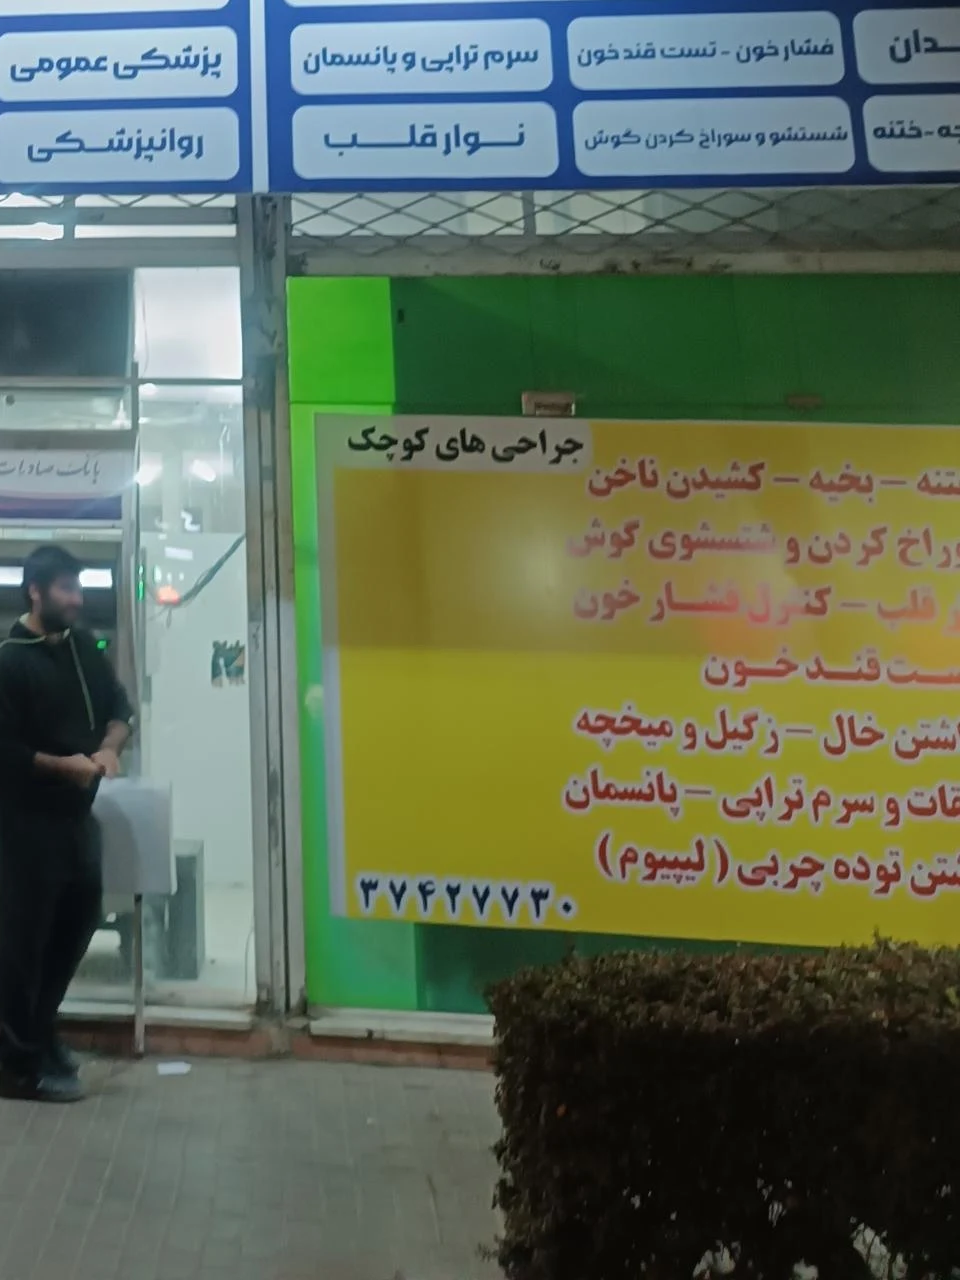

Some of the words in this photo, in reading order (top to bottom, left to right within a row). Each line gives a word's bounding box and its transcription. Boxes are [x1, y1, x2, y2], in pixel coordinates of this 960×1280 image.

[113, 45, 222, 80] پزشکی
[303, 45, 397, 74] پانسمان
[402, 51, 416, 69] و
[421, 43, 478, 73] تراپی
[483, 48, 539, 70] سرم
[577, 43, 619, 67] خون
[624, 42, 656, 59] قند
[660, 41, 716, 58] تست
[736, 39, 779, 63] خون
[783, 38, 835, 62] فشار
[889, 28, 960, 63] دان
[10, 55, 108, 82] عمومی
[27, 127, 204, 162] روانپزشکی
[324, 123, 437, 156] قلب
[443, 122, 526, 156] نوار
[584, 128, 641, 150] گوش
[645, 129, 694, 149] کردن
[699, 128, 751, 148] سوراخ
[755, 131, 767, 146] و
[770, 126, 848, 146] شستشو
[348, 426, 429, 461] کوچک
[436, 427, 486, 461] های
[492, 428, 583, 464] جراحی
[57, 451, 101, 484] بانک
[588, 458, 658, 496] ناخن
[666, 462, 765, 499] کشیدن
[809, 464, 874, 502] بخیه
[916, 469, 960, 495] تنه
[785, 535, 800, 564] و
[807, 527, 887, 565] کردن
[574, 579, 640, 618] خون
[650, 580, 739, 622] فشار
[877, 587, 935, 629] قلب
[704, 647, 798, 686] خون
[806, 648, 880, 682] قند
[576, 705, 673, 748] میخچه
[682, 720, 696, 749] و
[823, 713, 884, 755] خال
[565, 768, 677, 817] پانسمان
[721, 776, 804, 821] تراپی
[812, 787, 875, 824] سرم
[884, 795, 900, 826] و
[738, 851, 824, 892] چربی
[833, 850, 901, 894] توده
[360, 877, 572, 918] ۳۷۴۲۷۷۳۰
